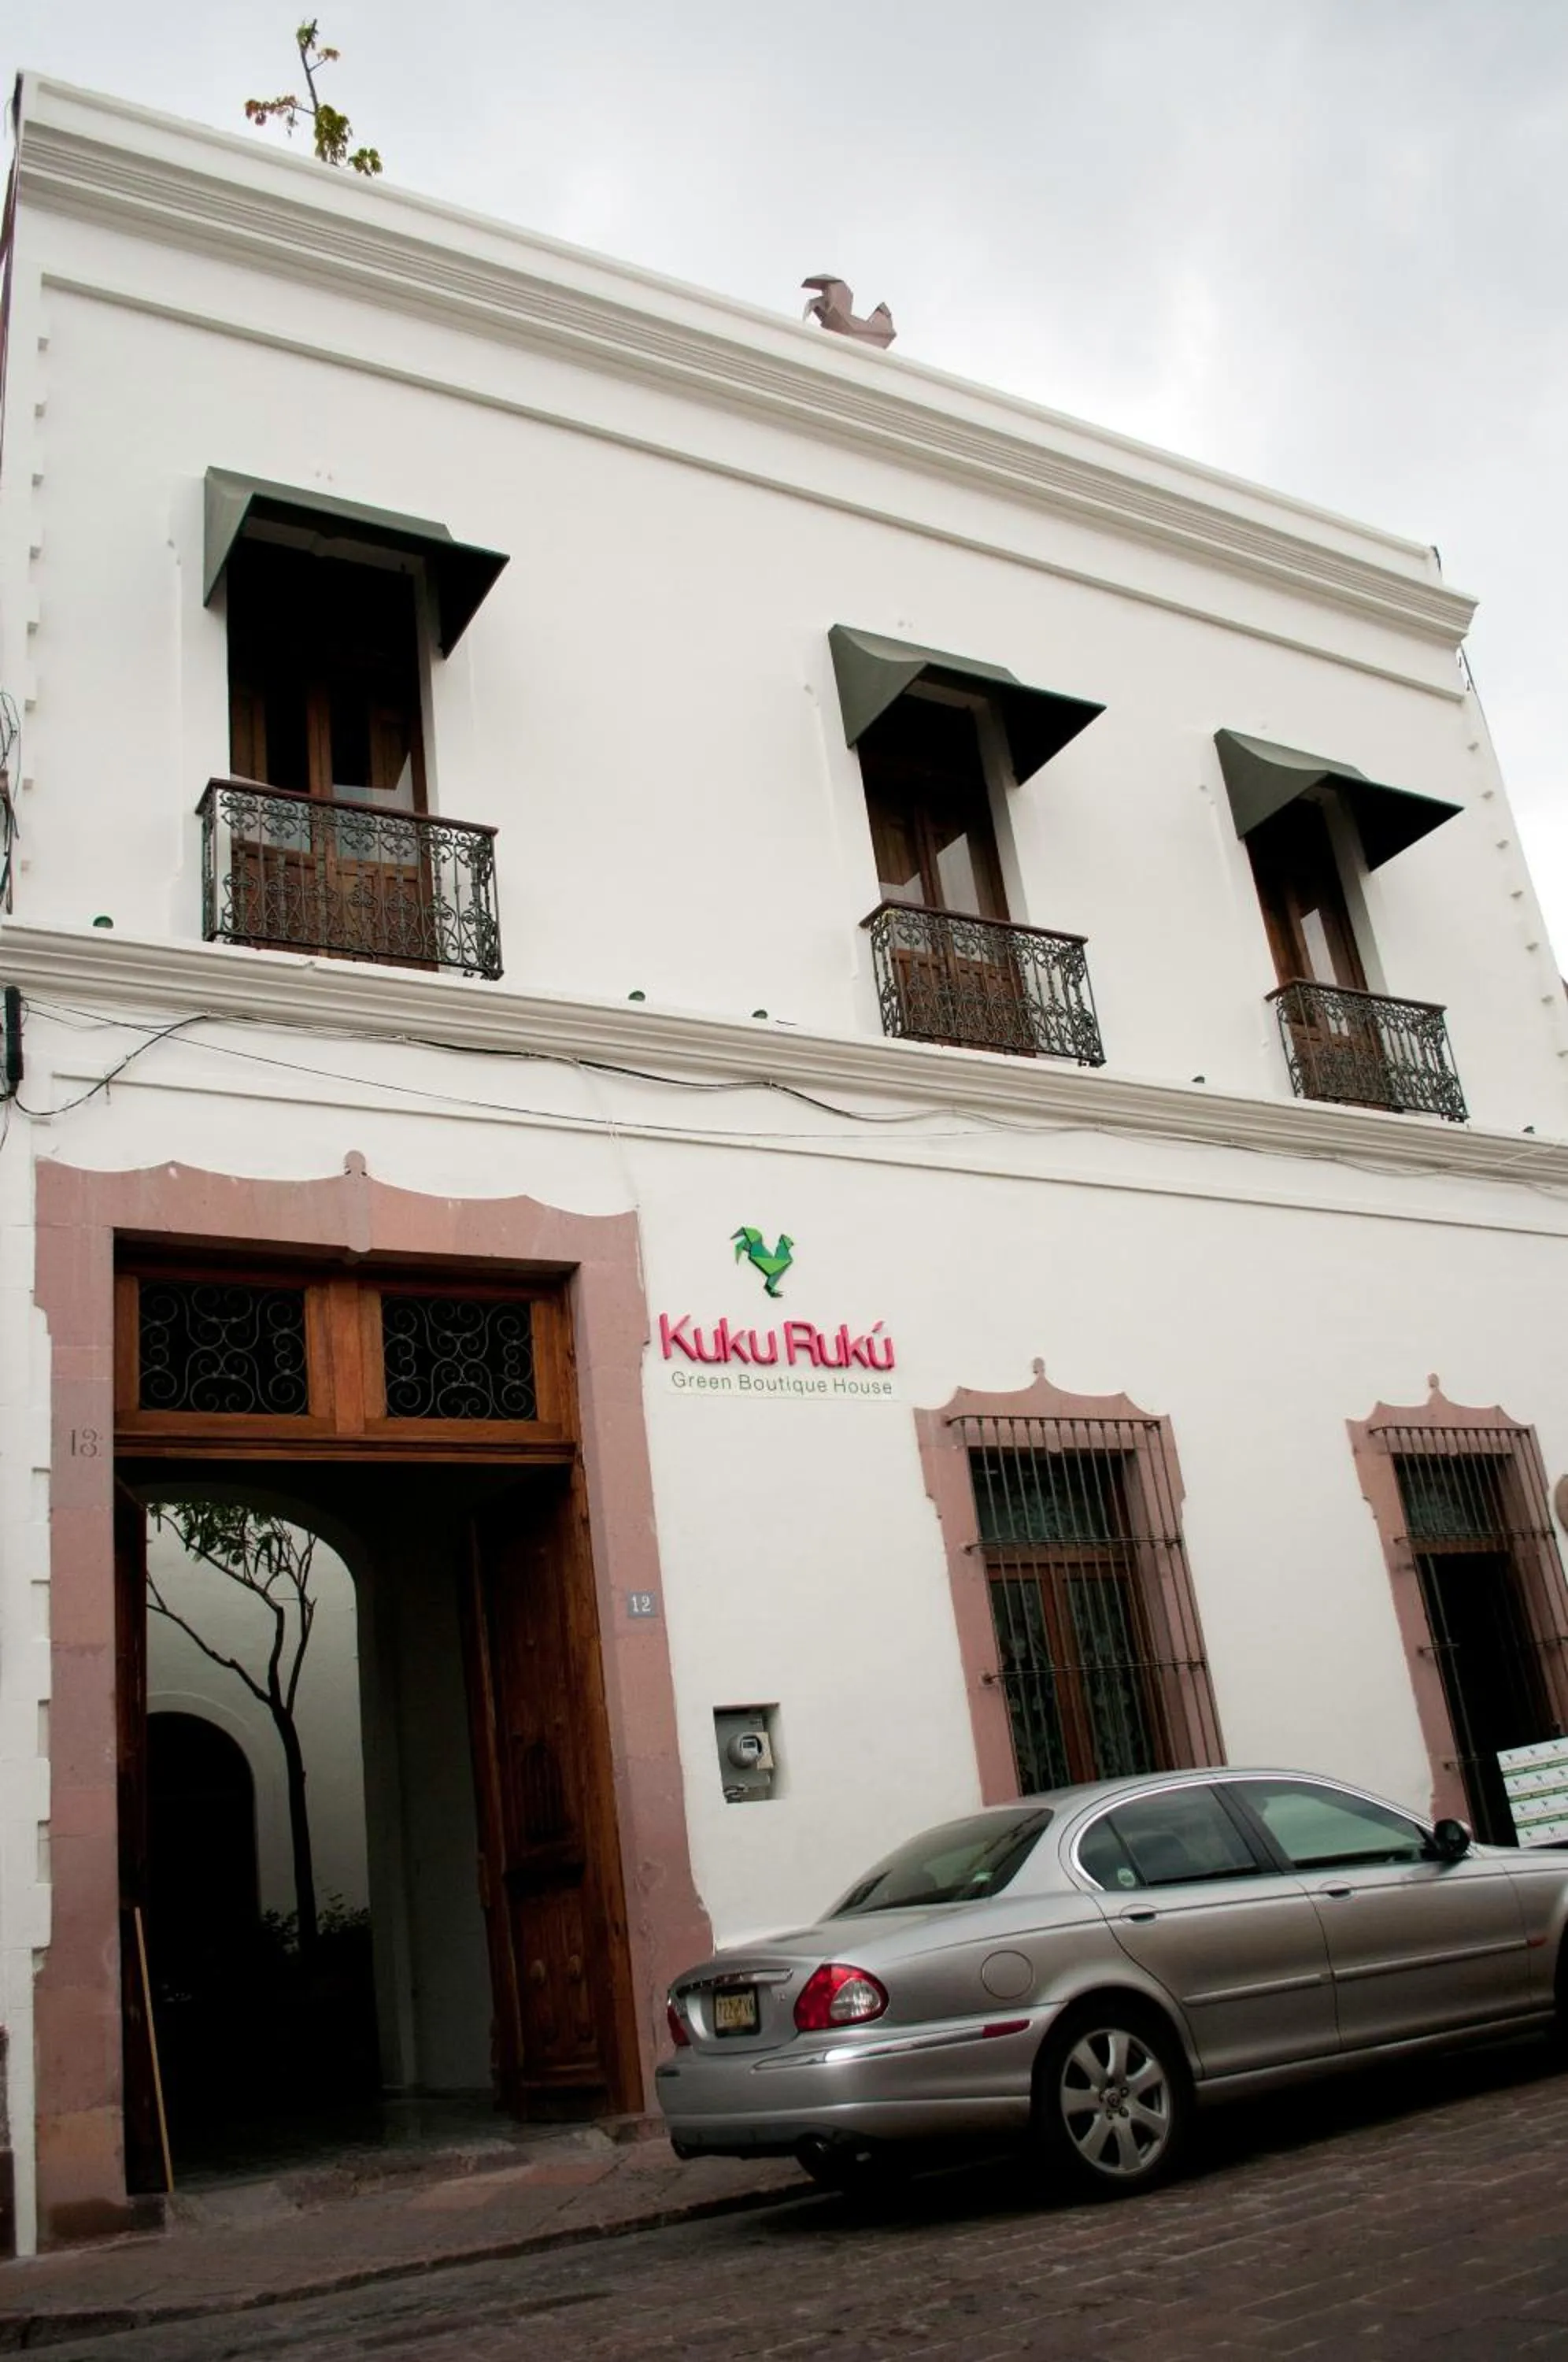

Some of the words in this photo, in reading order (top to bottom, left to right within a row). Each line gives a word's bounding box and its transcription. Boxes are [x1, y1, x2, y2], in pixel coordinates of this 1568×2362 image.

[671, 1371, 731, 1390] Green
[739, 1374, 827, 1395] Boutique
[834, 1377, 892, 1394] House
[631, 1594, 651, 1612] 12
